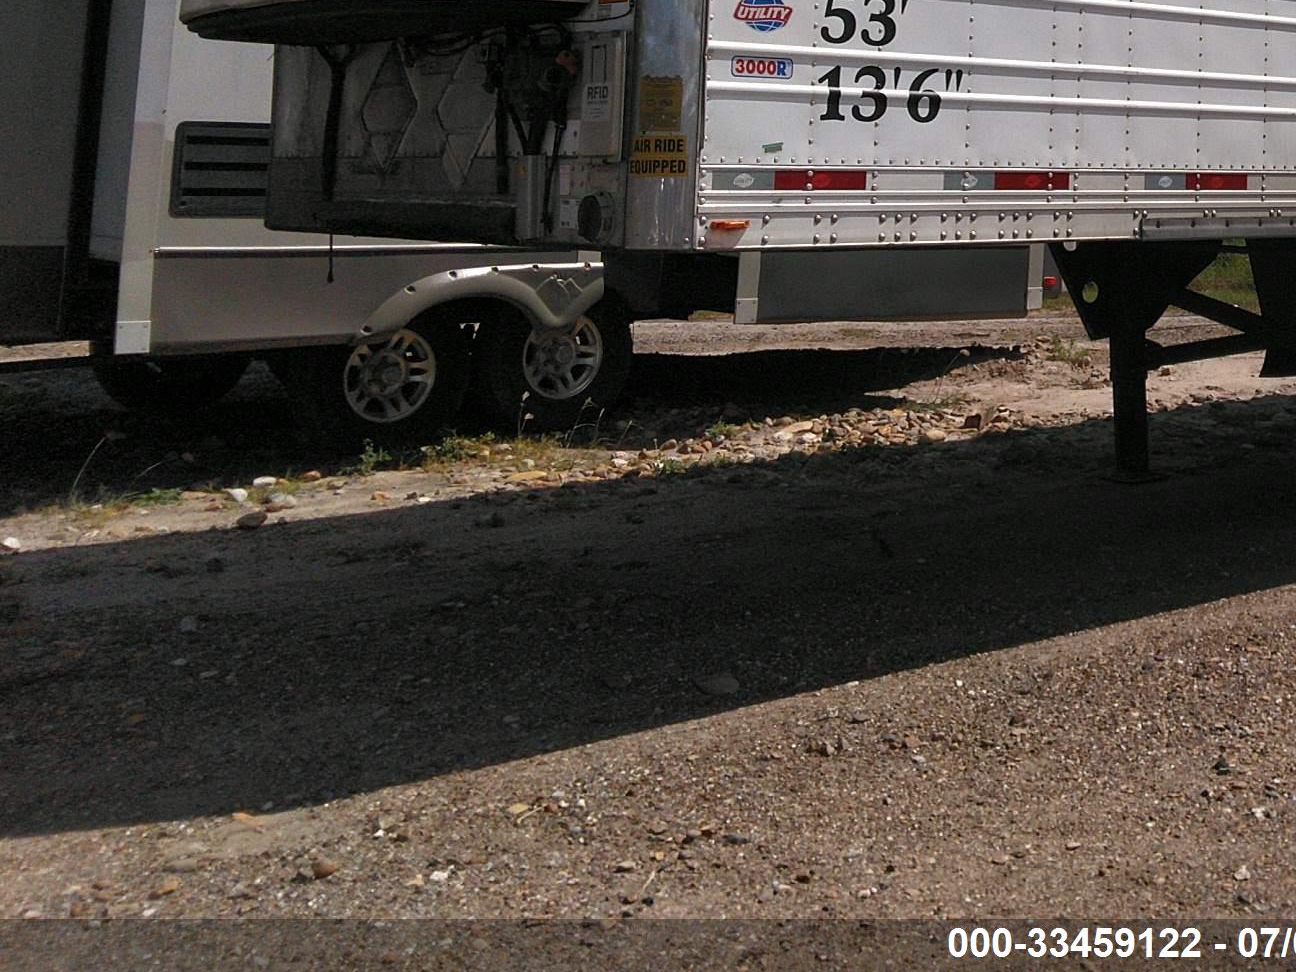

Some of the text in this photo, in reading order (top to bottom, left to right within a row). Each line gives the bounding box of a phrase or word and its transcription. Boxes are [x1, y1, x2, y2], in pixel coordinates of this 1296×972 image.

[736, 4, 791, 20] UTILITY
[735, 58, 787, 76] 3000R
[587, 85, 609, 101] RFID
[818, 65, 964, 124] 13'6"
[634, 138, 685, 153] AIR RIDE
[630, 159, 687, 174] EQUIPPED
